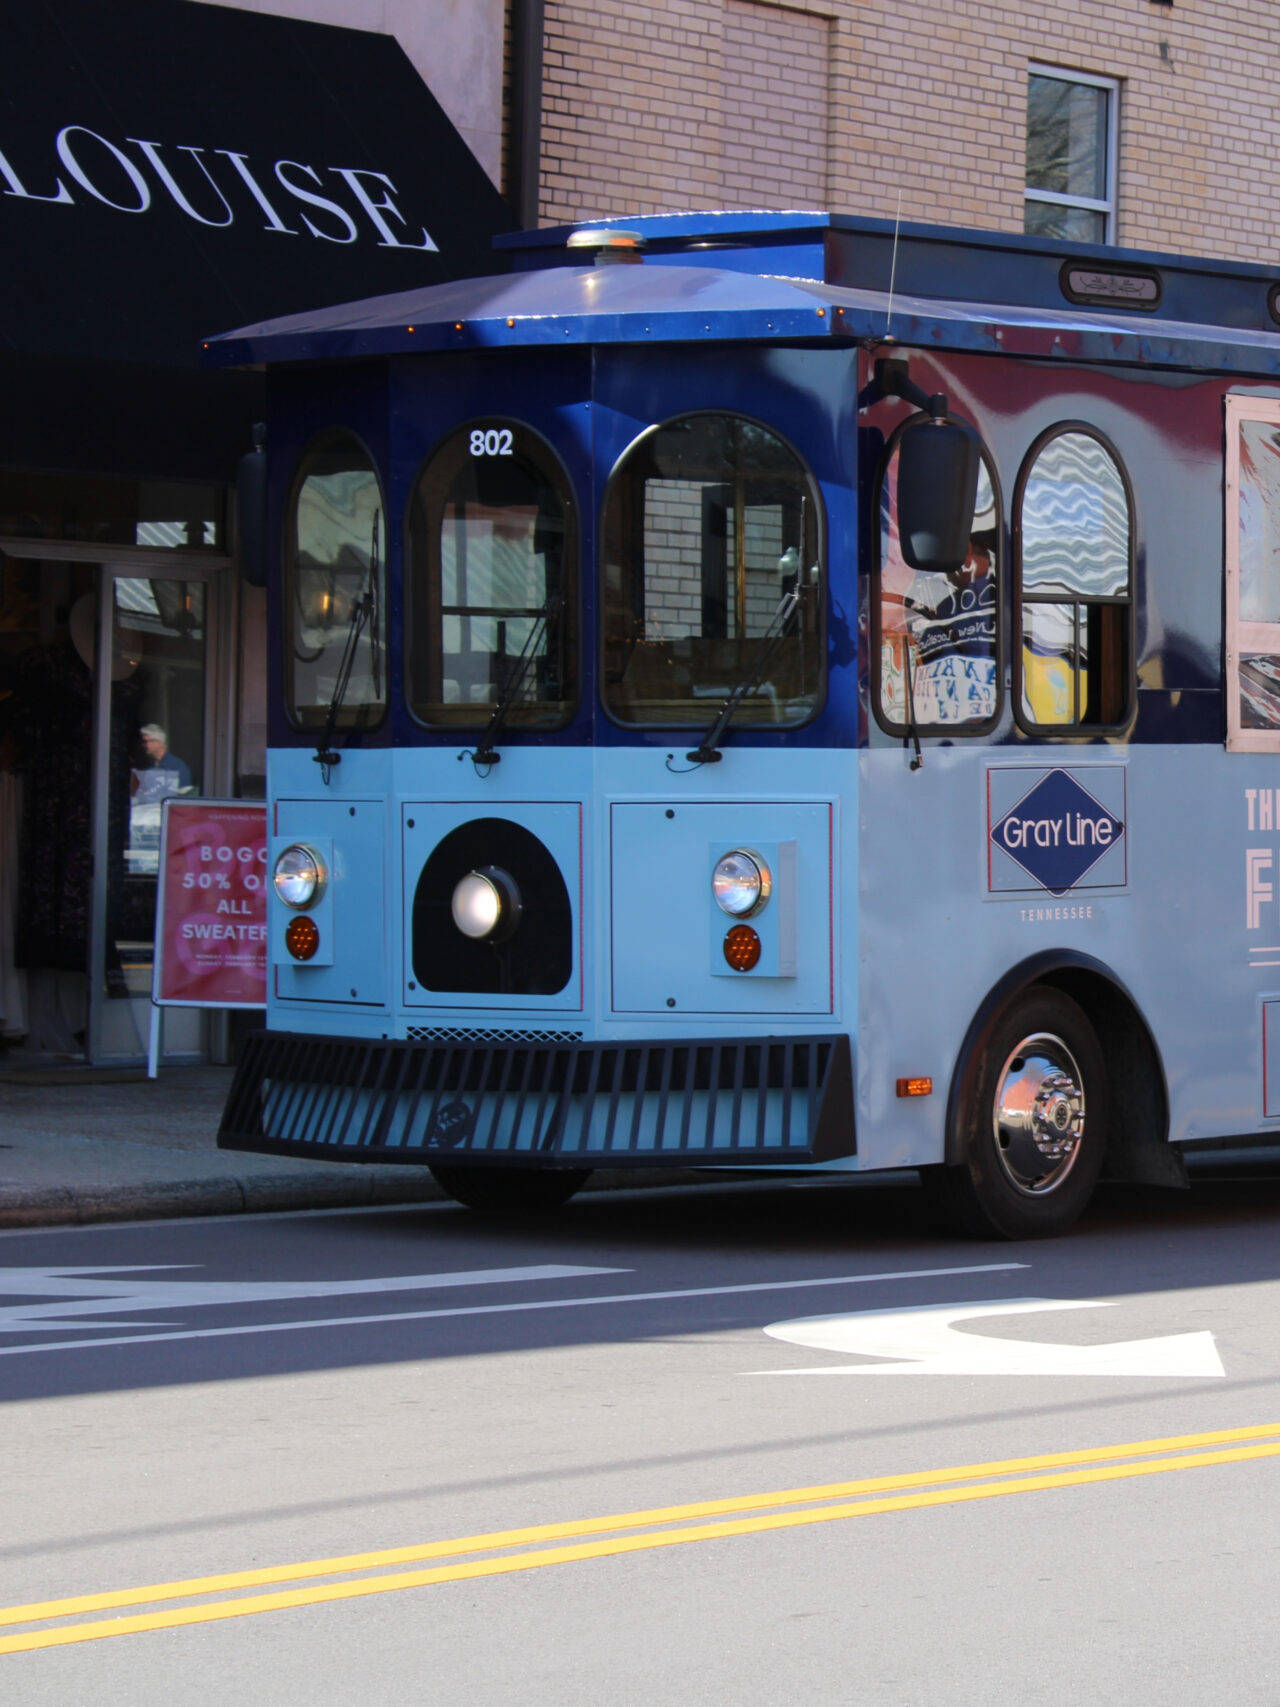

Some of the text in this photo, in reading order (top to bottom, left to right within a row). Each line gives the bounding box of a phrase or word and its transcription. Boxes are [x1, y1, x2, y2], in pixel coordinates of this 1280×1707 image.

[0, 126, 440, 252] LOUISE
[470, 429, 513, 456] 802
[182, 872, 267, 890] 50% O
[216, 899, 252, 914] ALL
[1020, 906, 1093, 922] TENNESSEE
